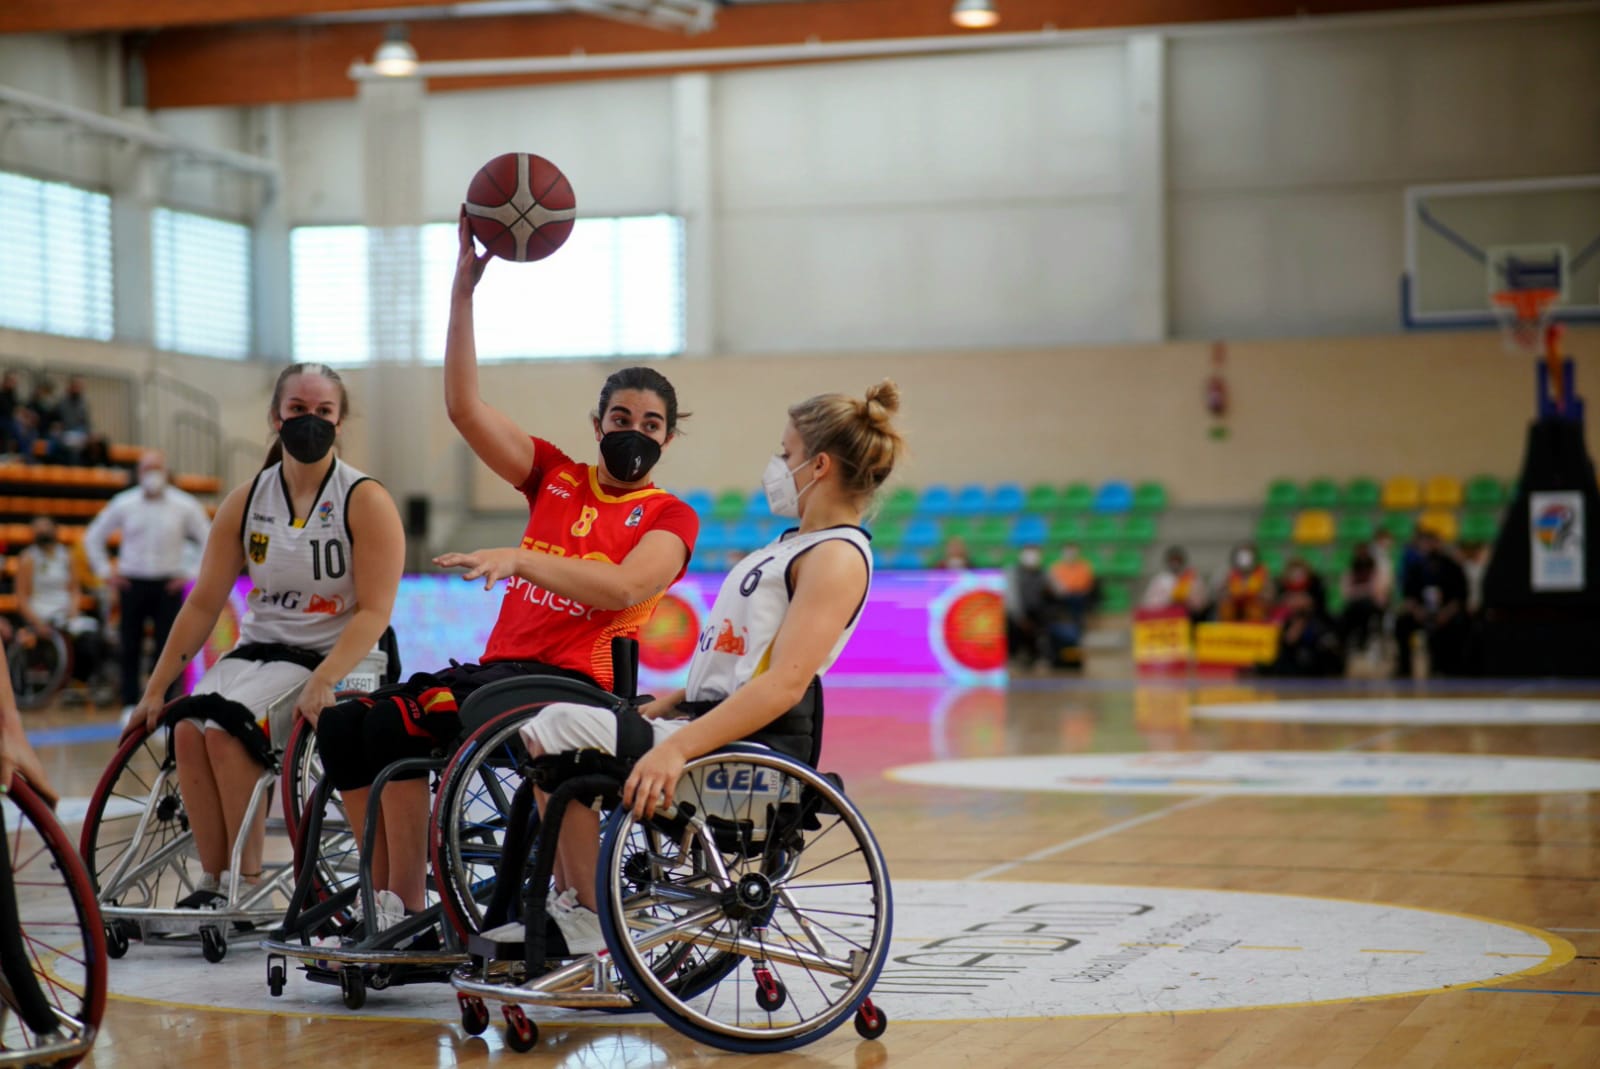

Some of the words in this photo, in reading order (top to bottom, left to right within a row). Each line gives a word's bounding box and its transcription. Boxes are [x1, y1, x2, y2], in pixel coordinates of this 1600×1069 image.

[570, 505, 599, 538] 8
[309, 538, 347, 581] 10
[739, 556, 775, 598] 6
[706, 768, 769, 792] GEL
